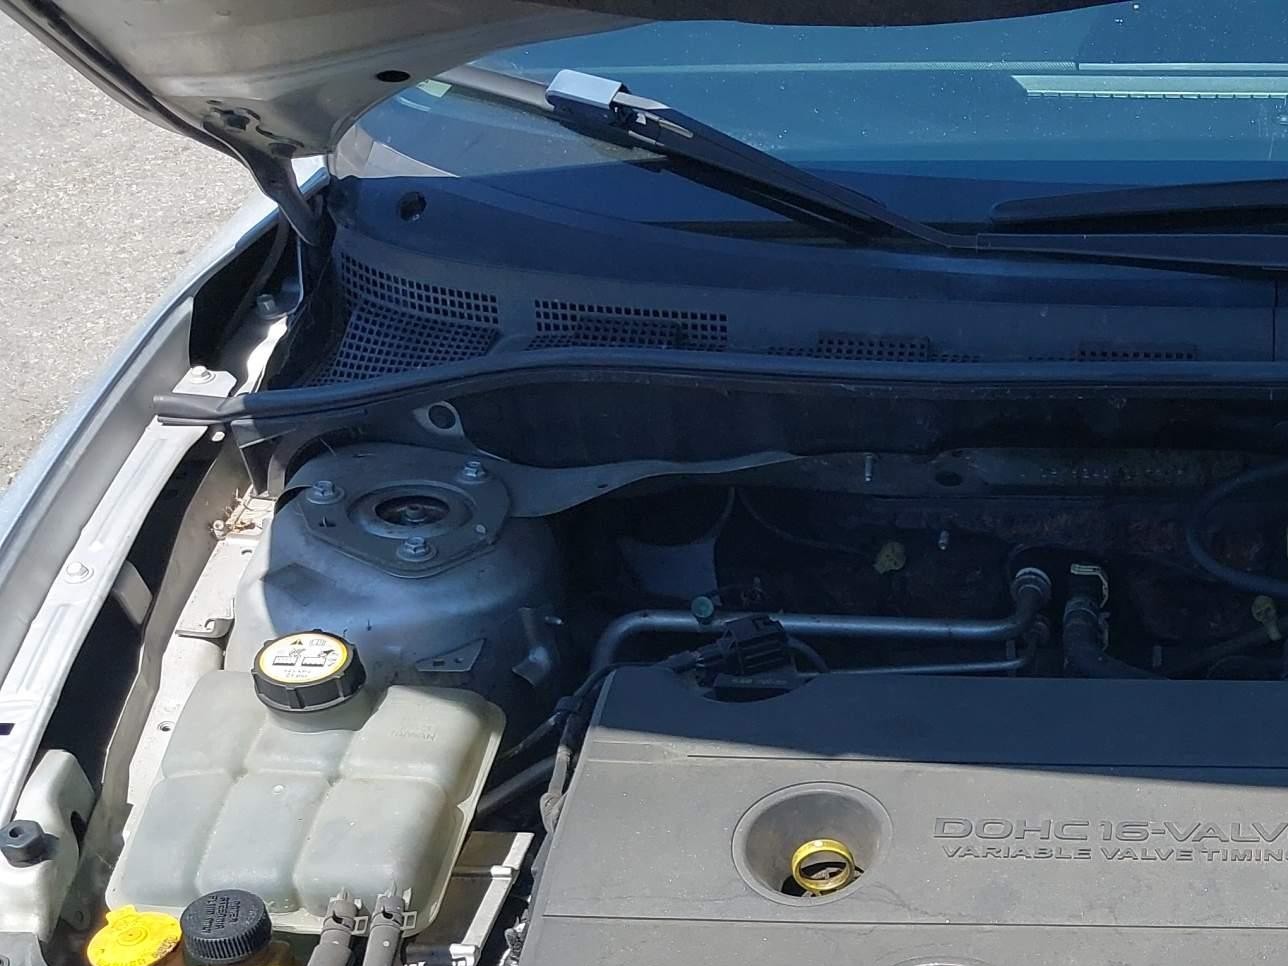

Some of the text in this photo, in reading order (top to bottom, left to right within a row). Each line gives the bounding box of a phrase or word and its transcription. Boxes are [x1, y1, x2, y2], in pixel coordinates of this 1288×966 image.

[933, 818, 1089, 840] DOHC
[942, 846, 1092, 859] VARIABLE
[1100, 847, 1193, 861] VALVE
